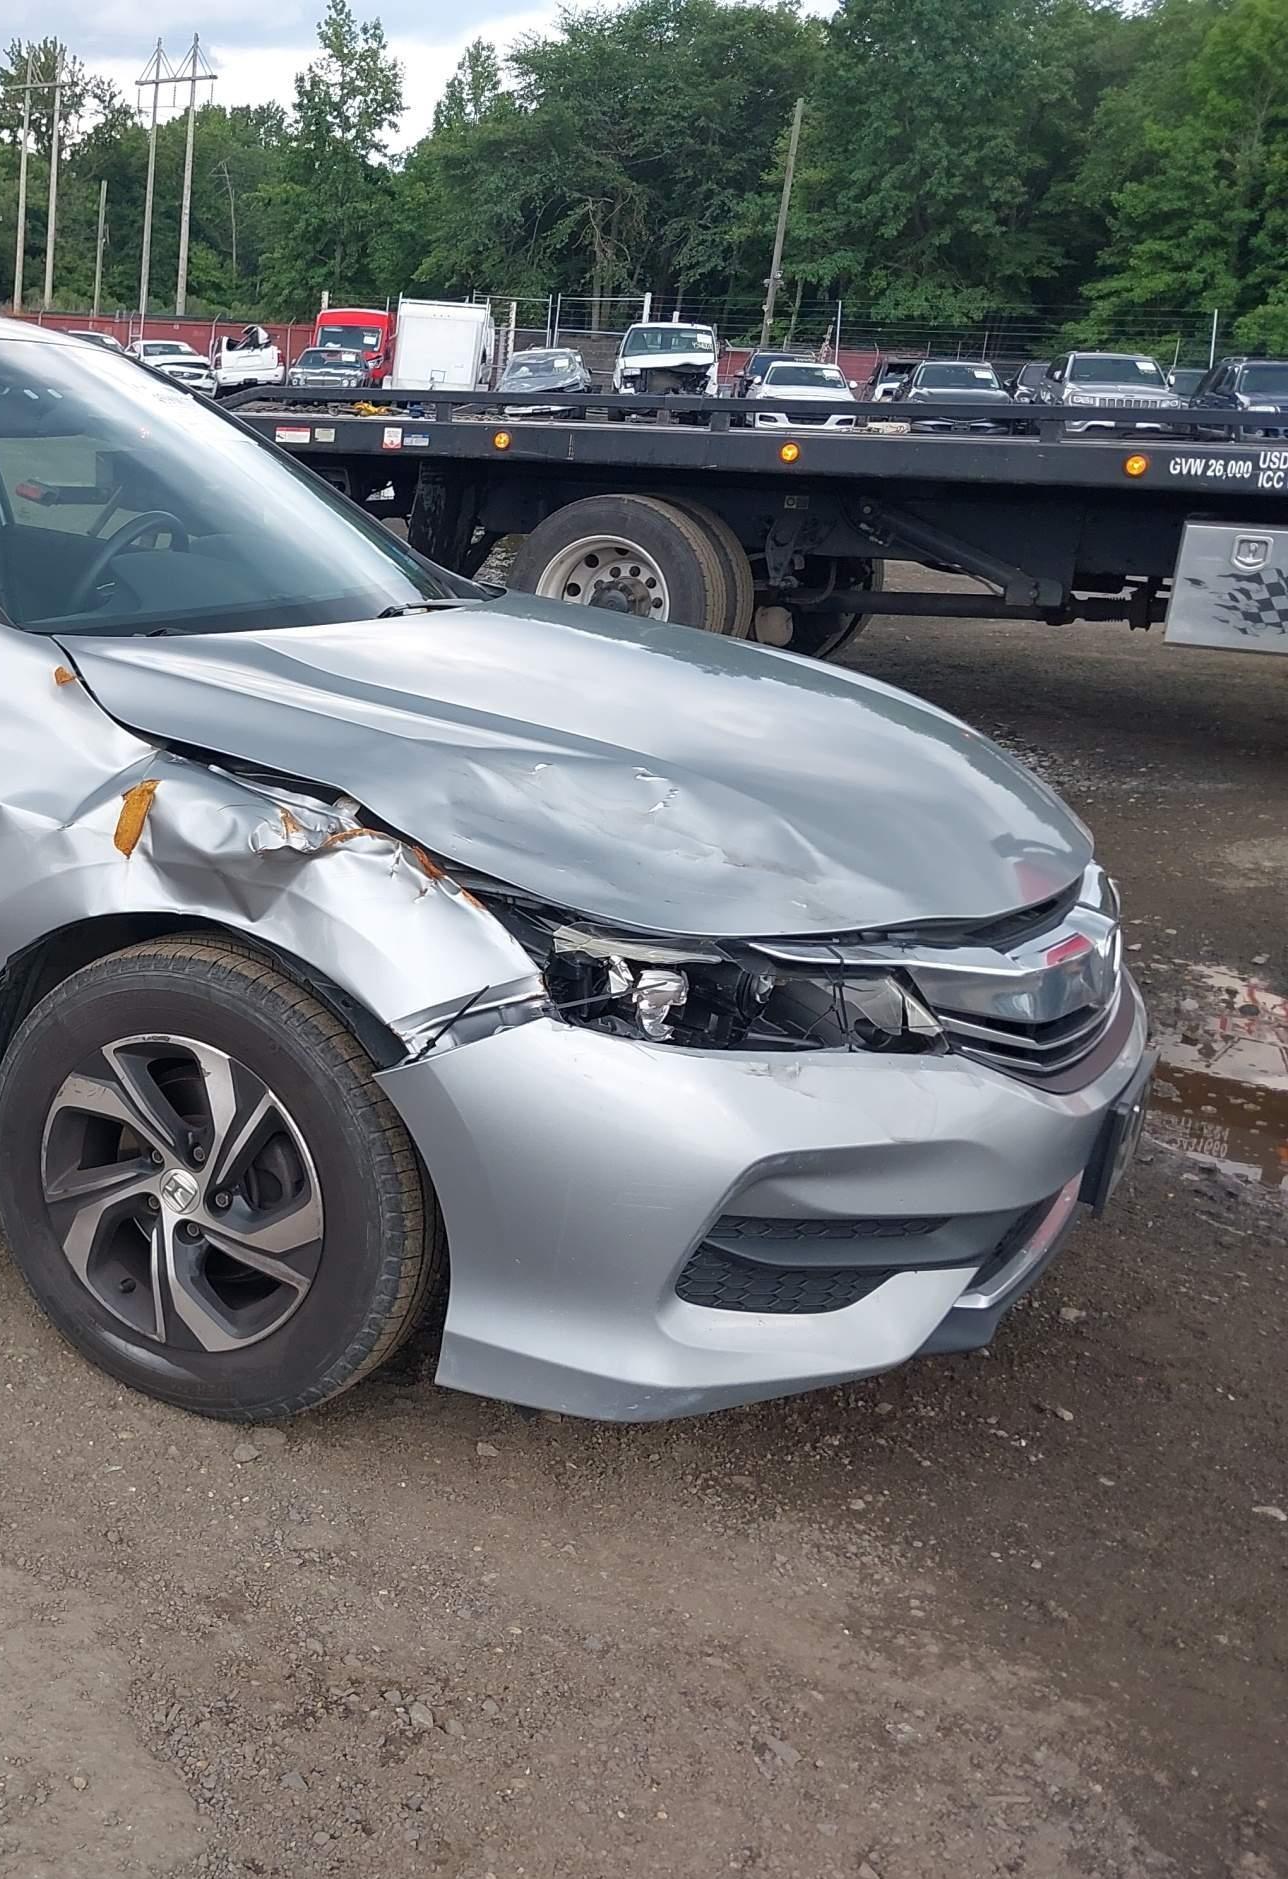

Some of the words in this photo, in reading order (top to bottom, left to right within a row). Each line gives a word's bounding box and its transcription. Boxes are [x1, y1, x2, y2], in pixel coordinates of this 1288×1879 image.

[1169, 457, 1205, 476] GVW
[1206, 459, 1252, 480] 26,000
[1258, 470, 1285, 488] ICC
